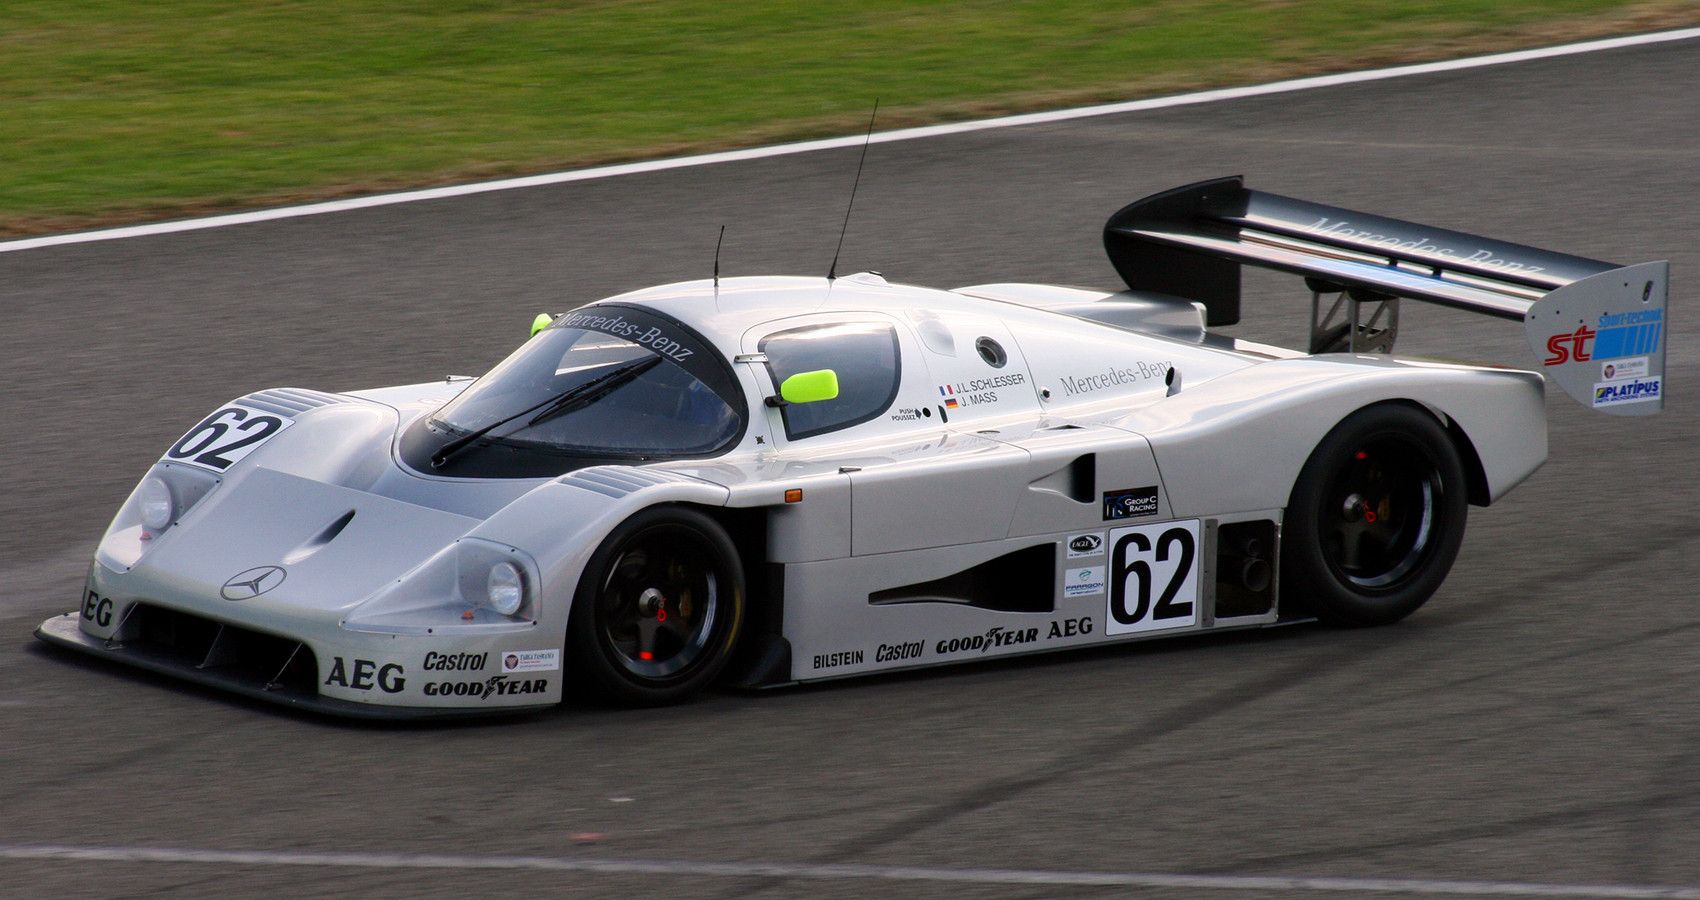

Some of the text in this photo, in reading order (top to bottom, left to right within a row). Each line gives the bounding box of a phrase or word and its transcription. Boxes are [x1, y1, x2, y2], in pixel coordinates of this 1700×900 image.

[552, 312, 695, 363] Mercedes-Benz
[1544, 325, 1596, 366] st
[970, 392, 998, 405] MASS
[168, 407, 283, 470] 62
[1129, 503, 1157, 513] RACING
[1110, 527, 1195, 625] 62
[83, 586, 113, 627] EG
[936, 627, 1039, 654] GOODYEAR
[1046, 616, 1094, 640] AEG
[423, 651, 488, 671] Castrol
[813, 650, 864, 669] BILSTEIN
[875, 639, 925, 663] Castrol
[325, 656, 405, 694] AEG
[423, 676, 548, 700] GOODYEAR
